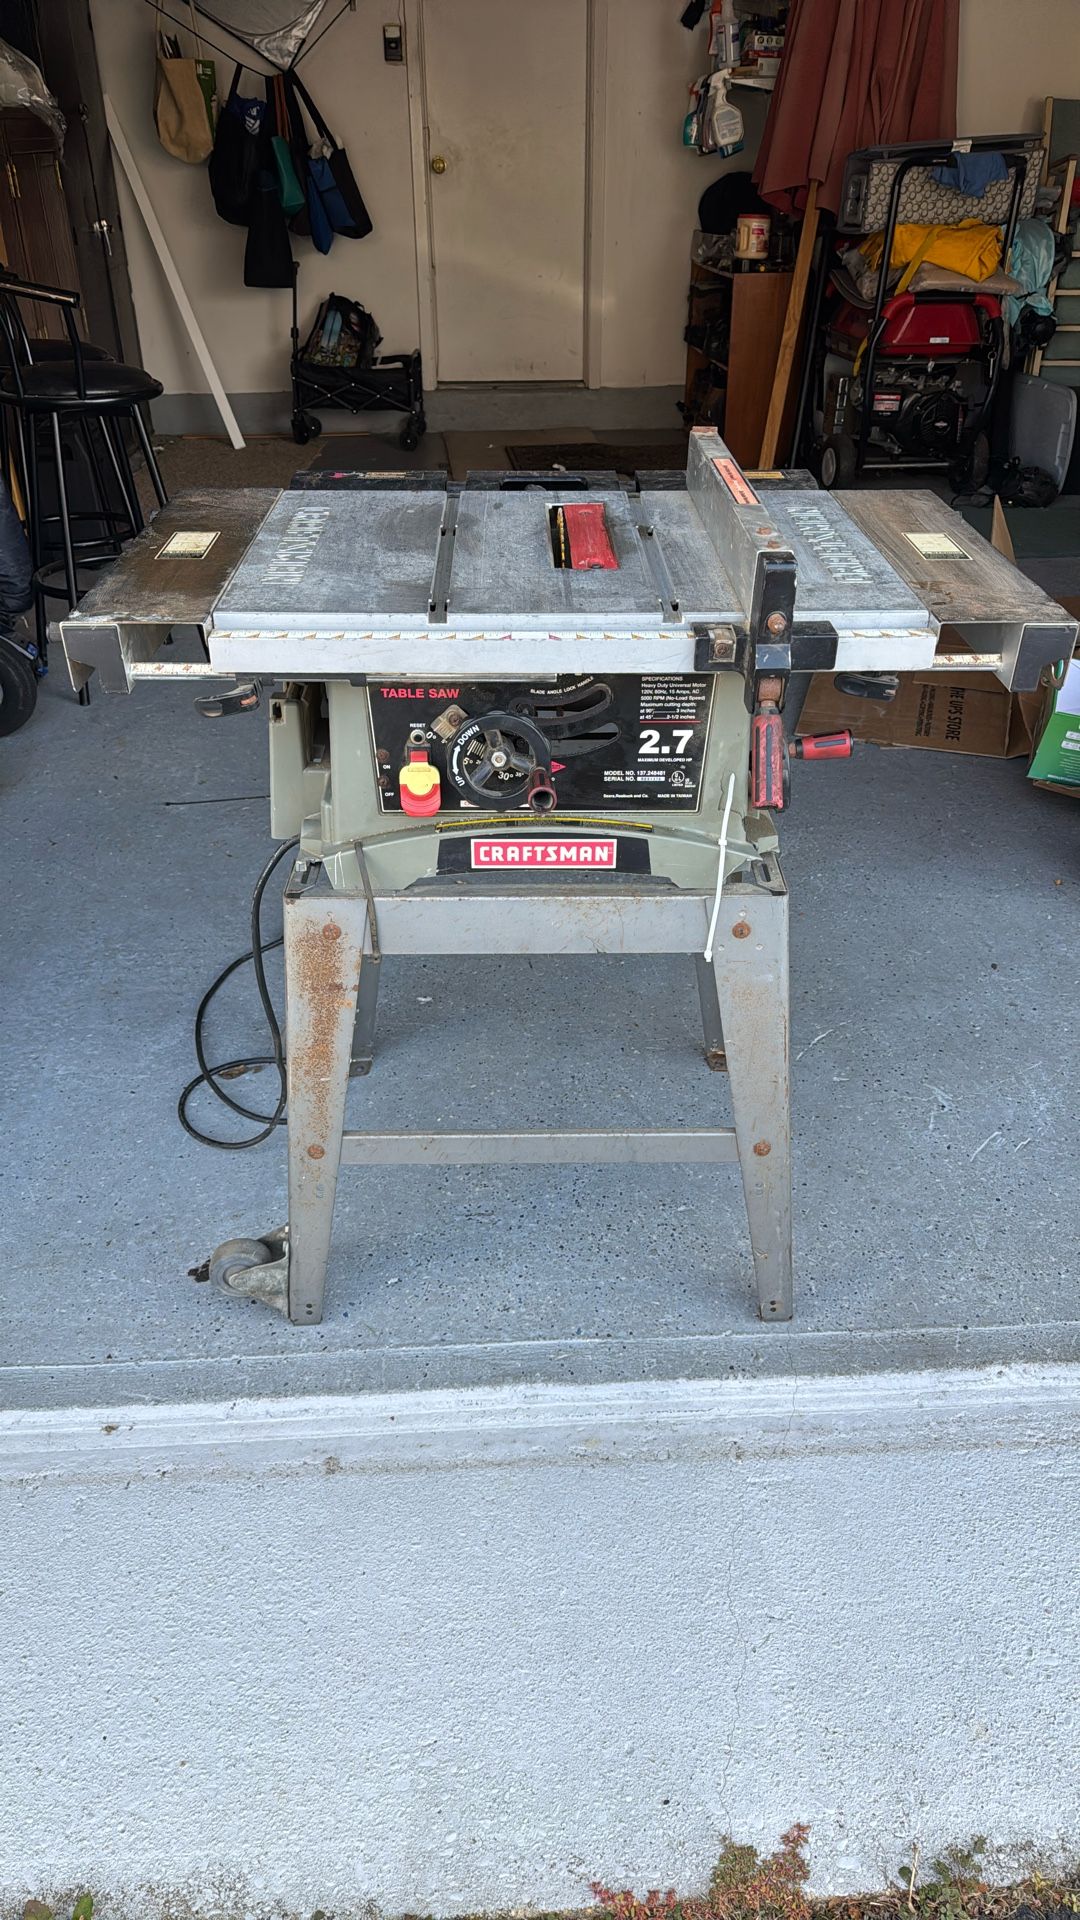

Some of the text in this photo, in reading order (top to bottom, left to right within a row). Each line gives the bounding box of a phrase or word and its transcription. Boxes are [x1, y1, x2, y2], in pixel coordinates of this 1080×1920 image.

[563, 685, 576, 693] LOCK
[577, 675, 594, 687] HANDLE
[380, 688, 460, 698] TABLE SAW
[948, 699, 965, 715] UPS
[457, 724, 480, 746] DOWN
[945, 715, 962, 742] STORE
[638, 729, 694, 754] 2.7
[454, 775, 466, 787] UP
[497, 771, 514, 781] 30°
[479, 845, 609, 862] CRAFTSMAN
